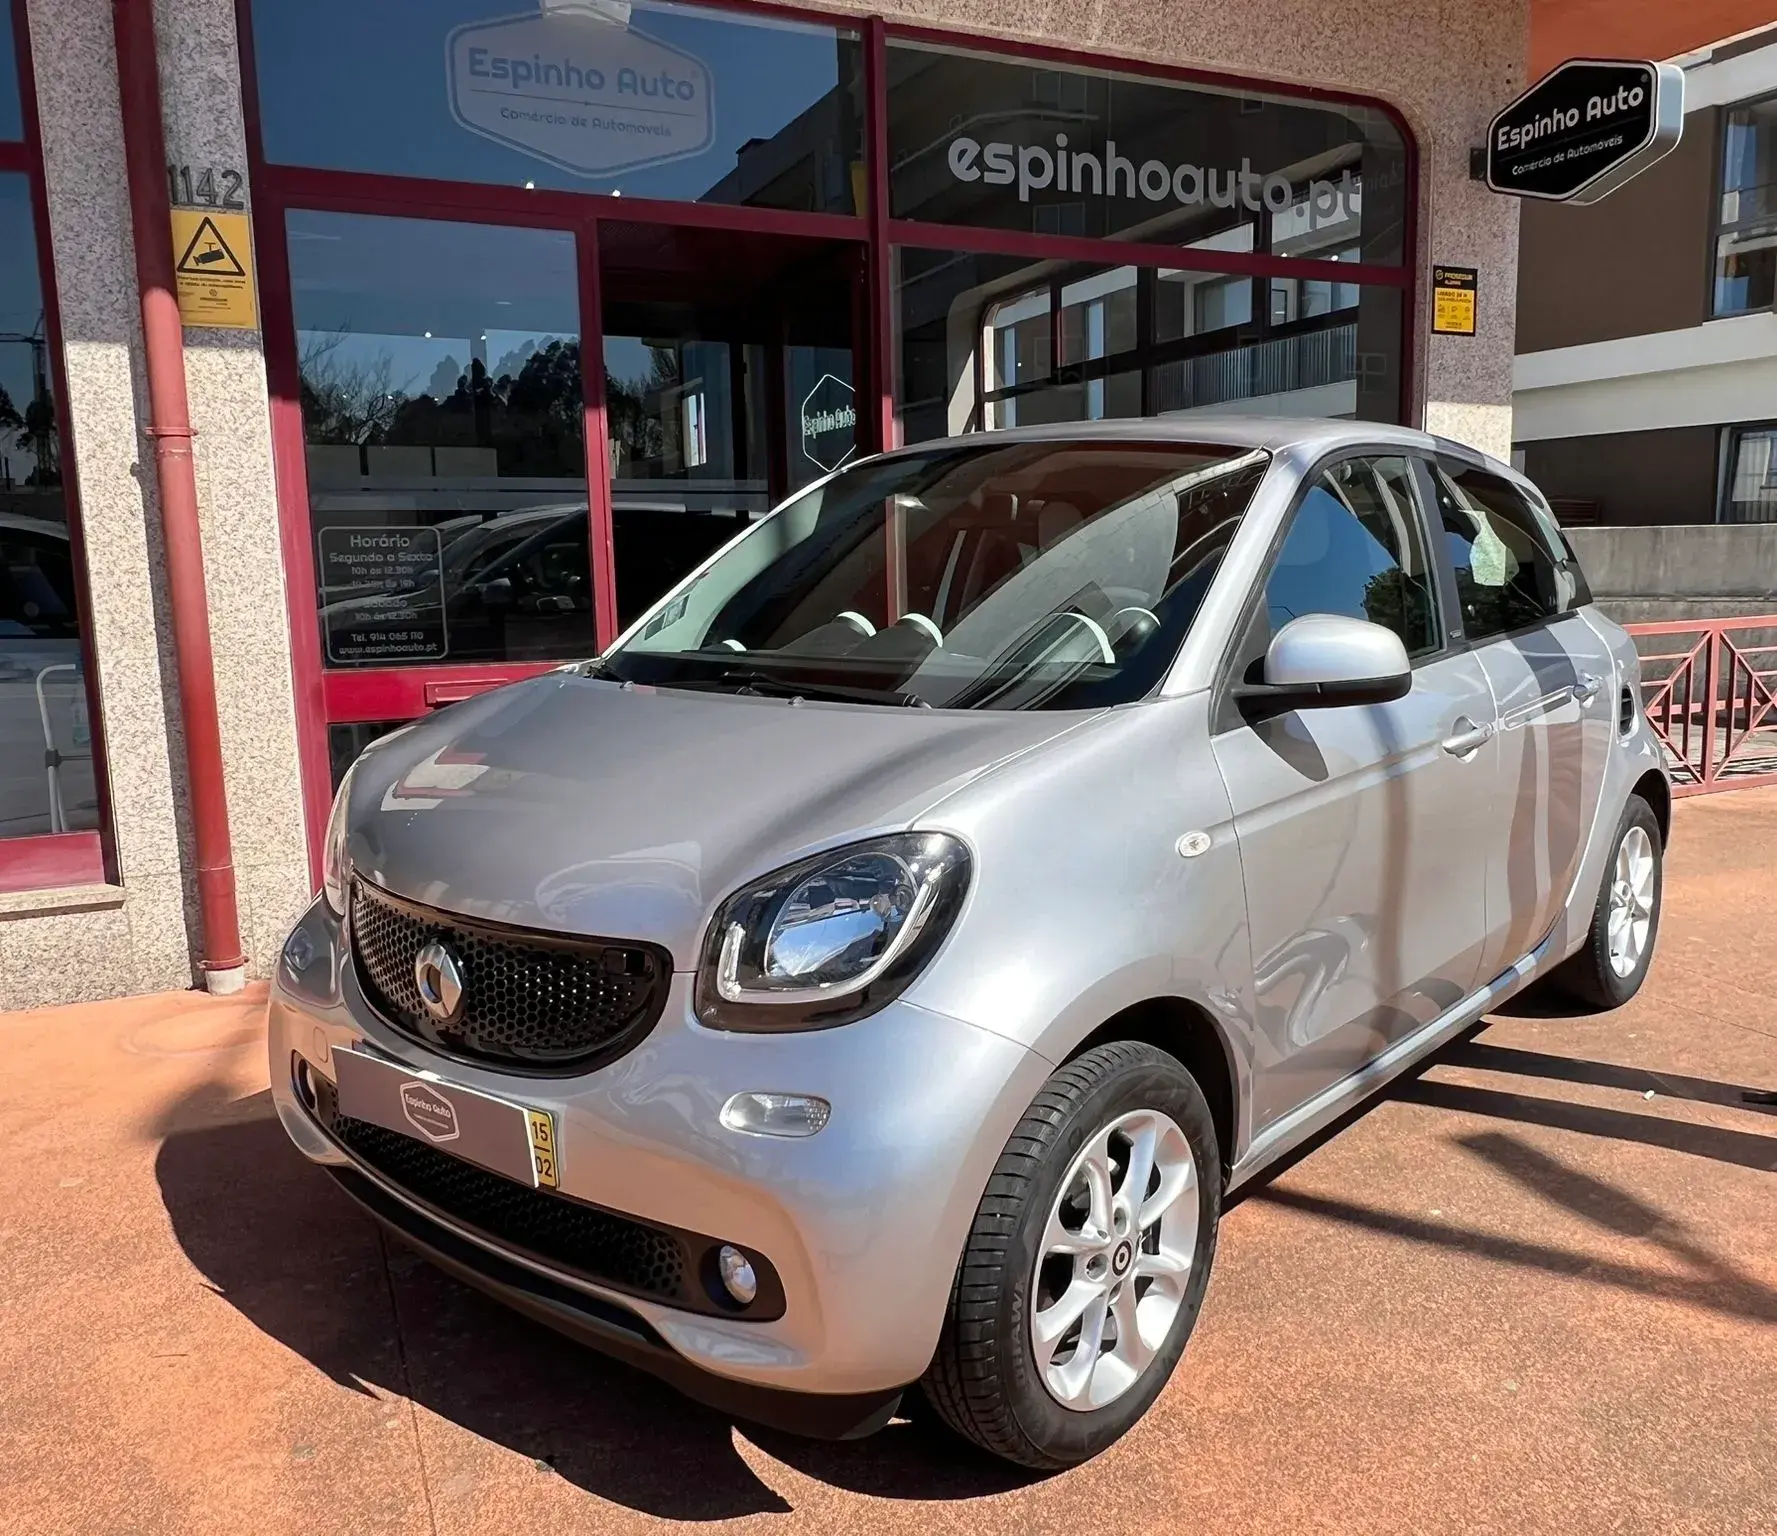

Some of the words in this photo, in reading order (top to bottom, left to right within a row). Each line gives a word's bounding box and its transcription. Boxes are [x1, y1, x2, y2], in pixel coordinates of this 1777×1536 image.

[468, 47, 606, 90] Espinho
[617, 66, 696, 101] Auto
[571, 115, 588, 128] de
[1497, 108, 1579, 151] Espinho
[1586, 85, 1644, 122] Auto
[1553, 152, 1565, 163] de
[167, 164, 244, 210] 1142
[948, 132, 1362, 232] espinhoauto.pt
[349, 533, 410, 548] Horário
[532, 1121, 548, 1141] 15
[535, 1156, 553, 1178] 02
